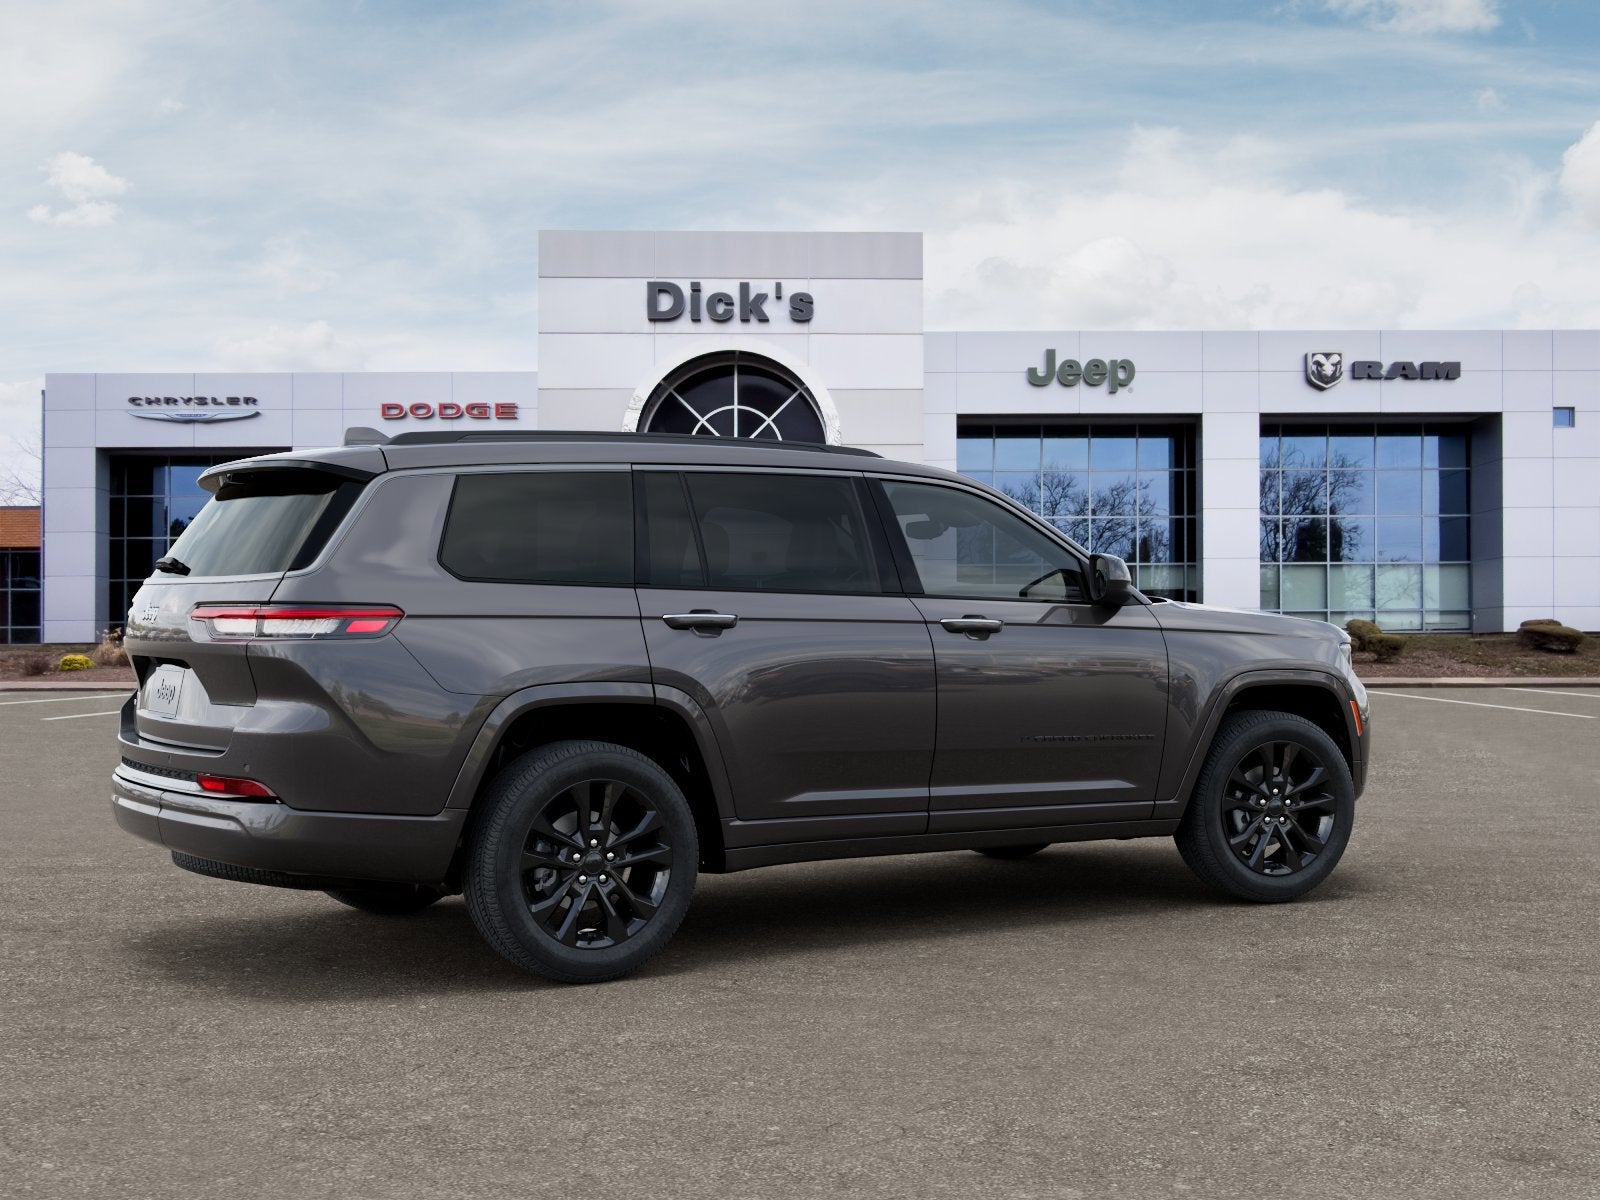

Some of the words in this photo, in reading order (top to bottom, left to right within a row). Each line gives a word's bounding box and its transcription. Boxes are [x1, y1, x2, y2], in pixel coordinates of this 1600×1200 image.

[647, 281, 815, 322] Dick's
[1027, 348, 1136, 394] Jeep
[1352, 360, 1462, 381] RAM
[127, 396, 259, 407] CHRYSLER
[381, 402, 519, 420] DODGE
